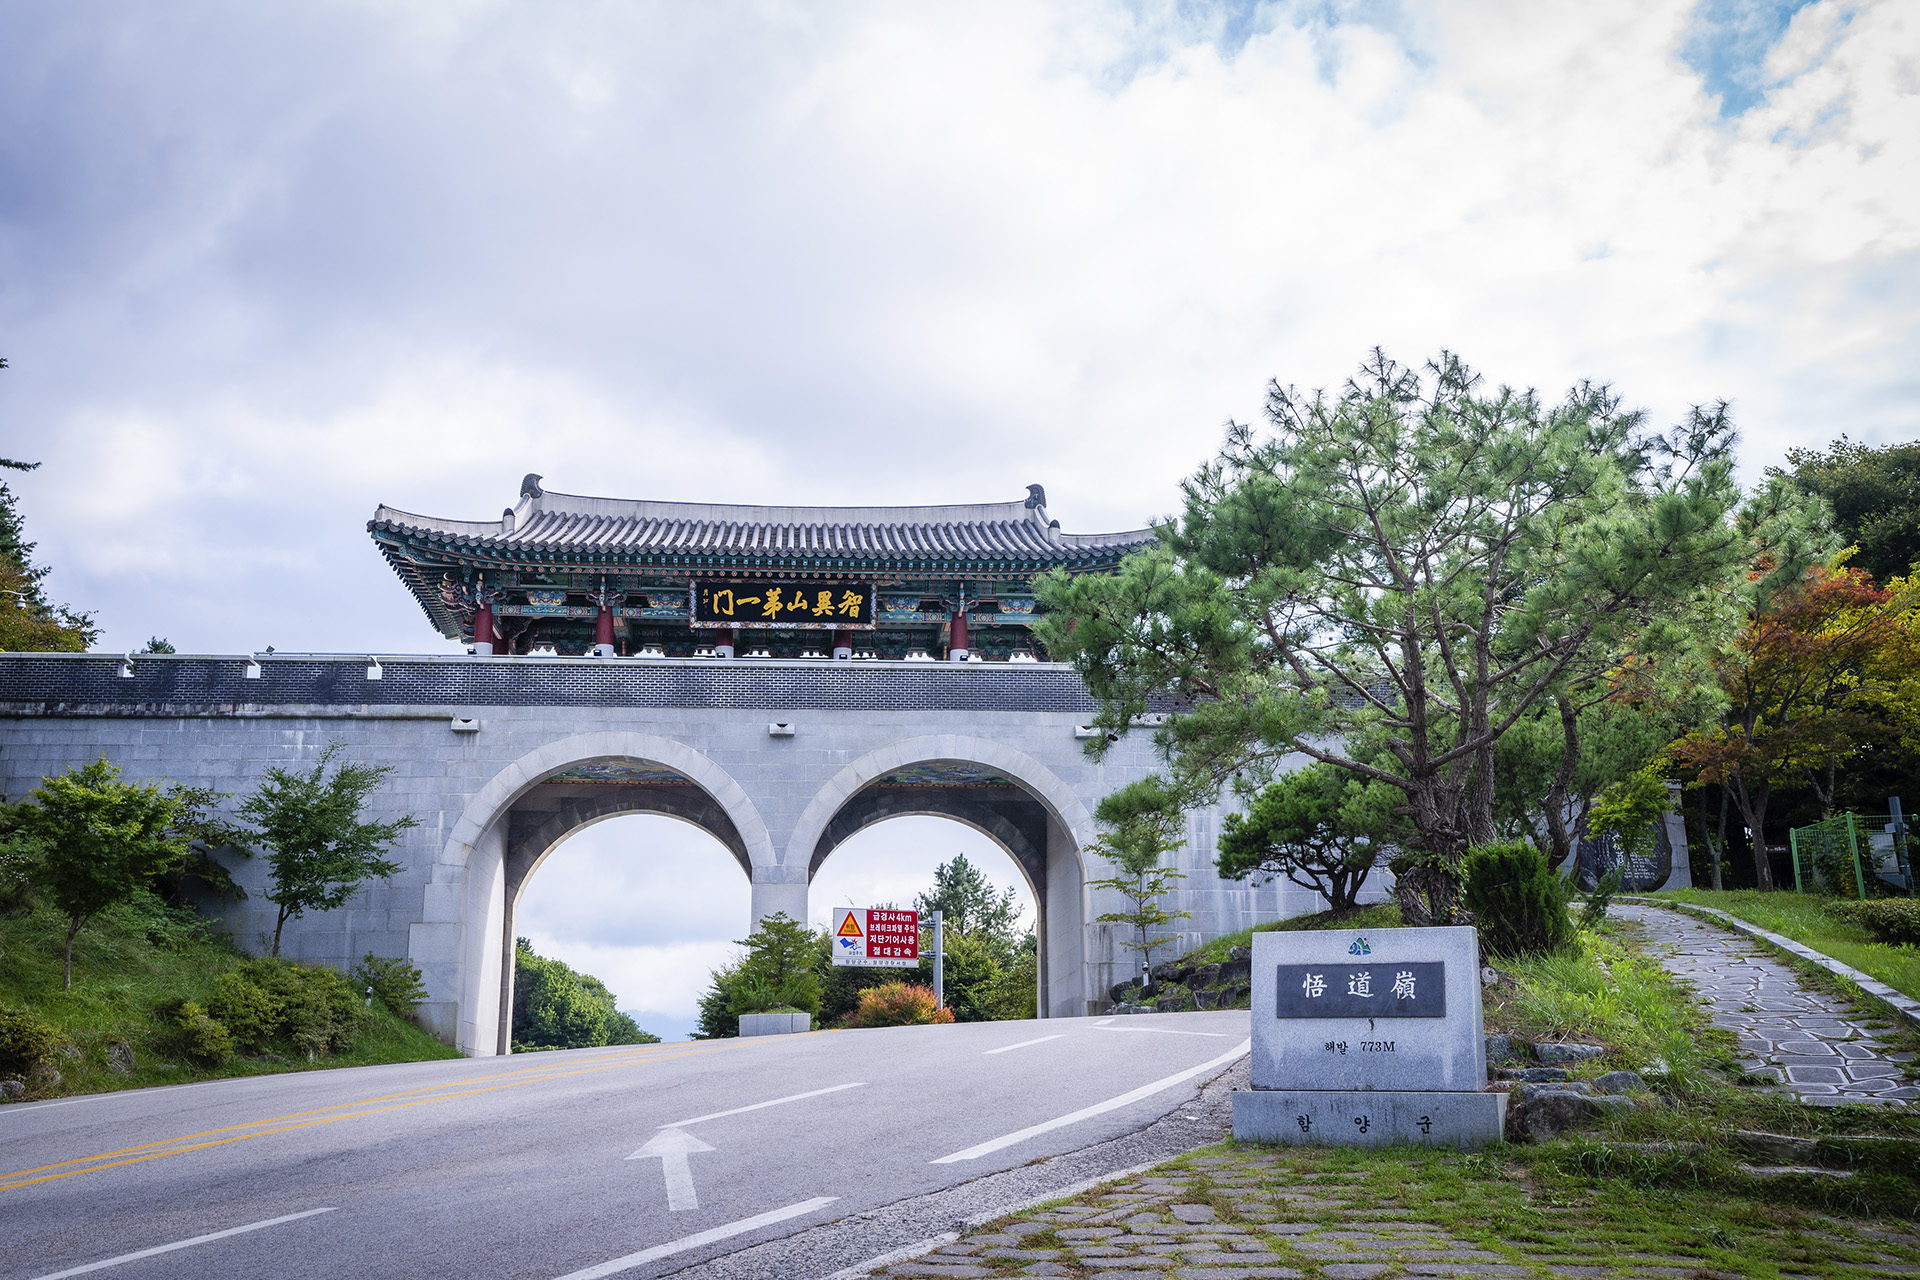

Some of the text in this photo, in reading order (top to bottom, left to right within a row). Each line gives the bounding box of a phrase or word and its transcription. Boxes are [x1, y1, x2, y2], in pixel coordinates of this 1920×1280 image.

[904, 924, 915, 933] 주의
[870, 935, 914, 944] 저단기어사용
[1324, 1041, 1395, 1055] 해발 773M
